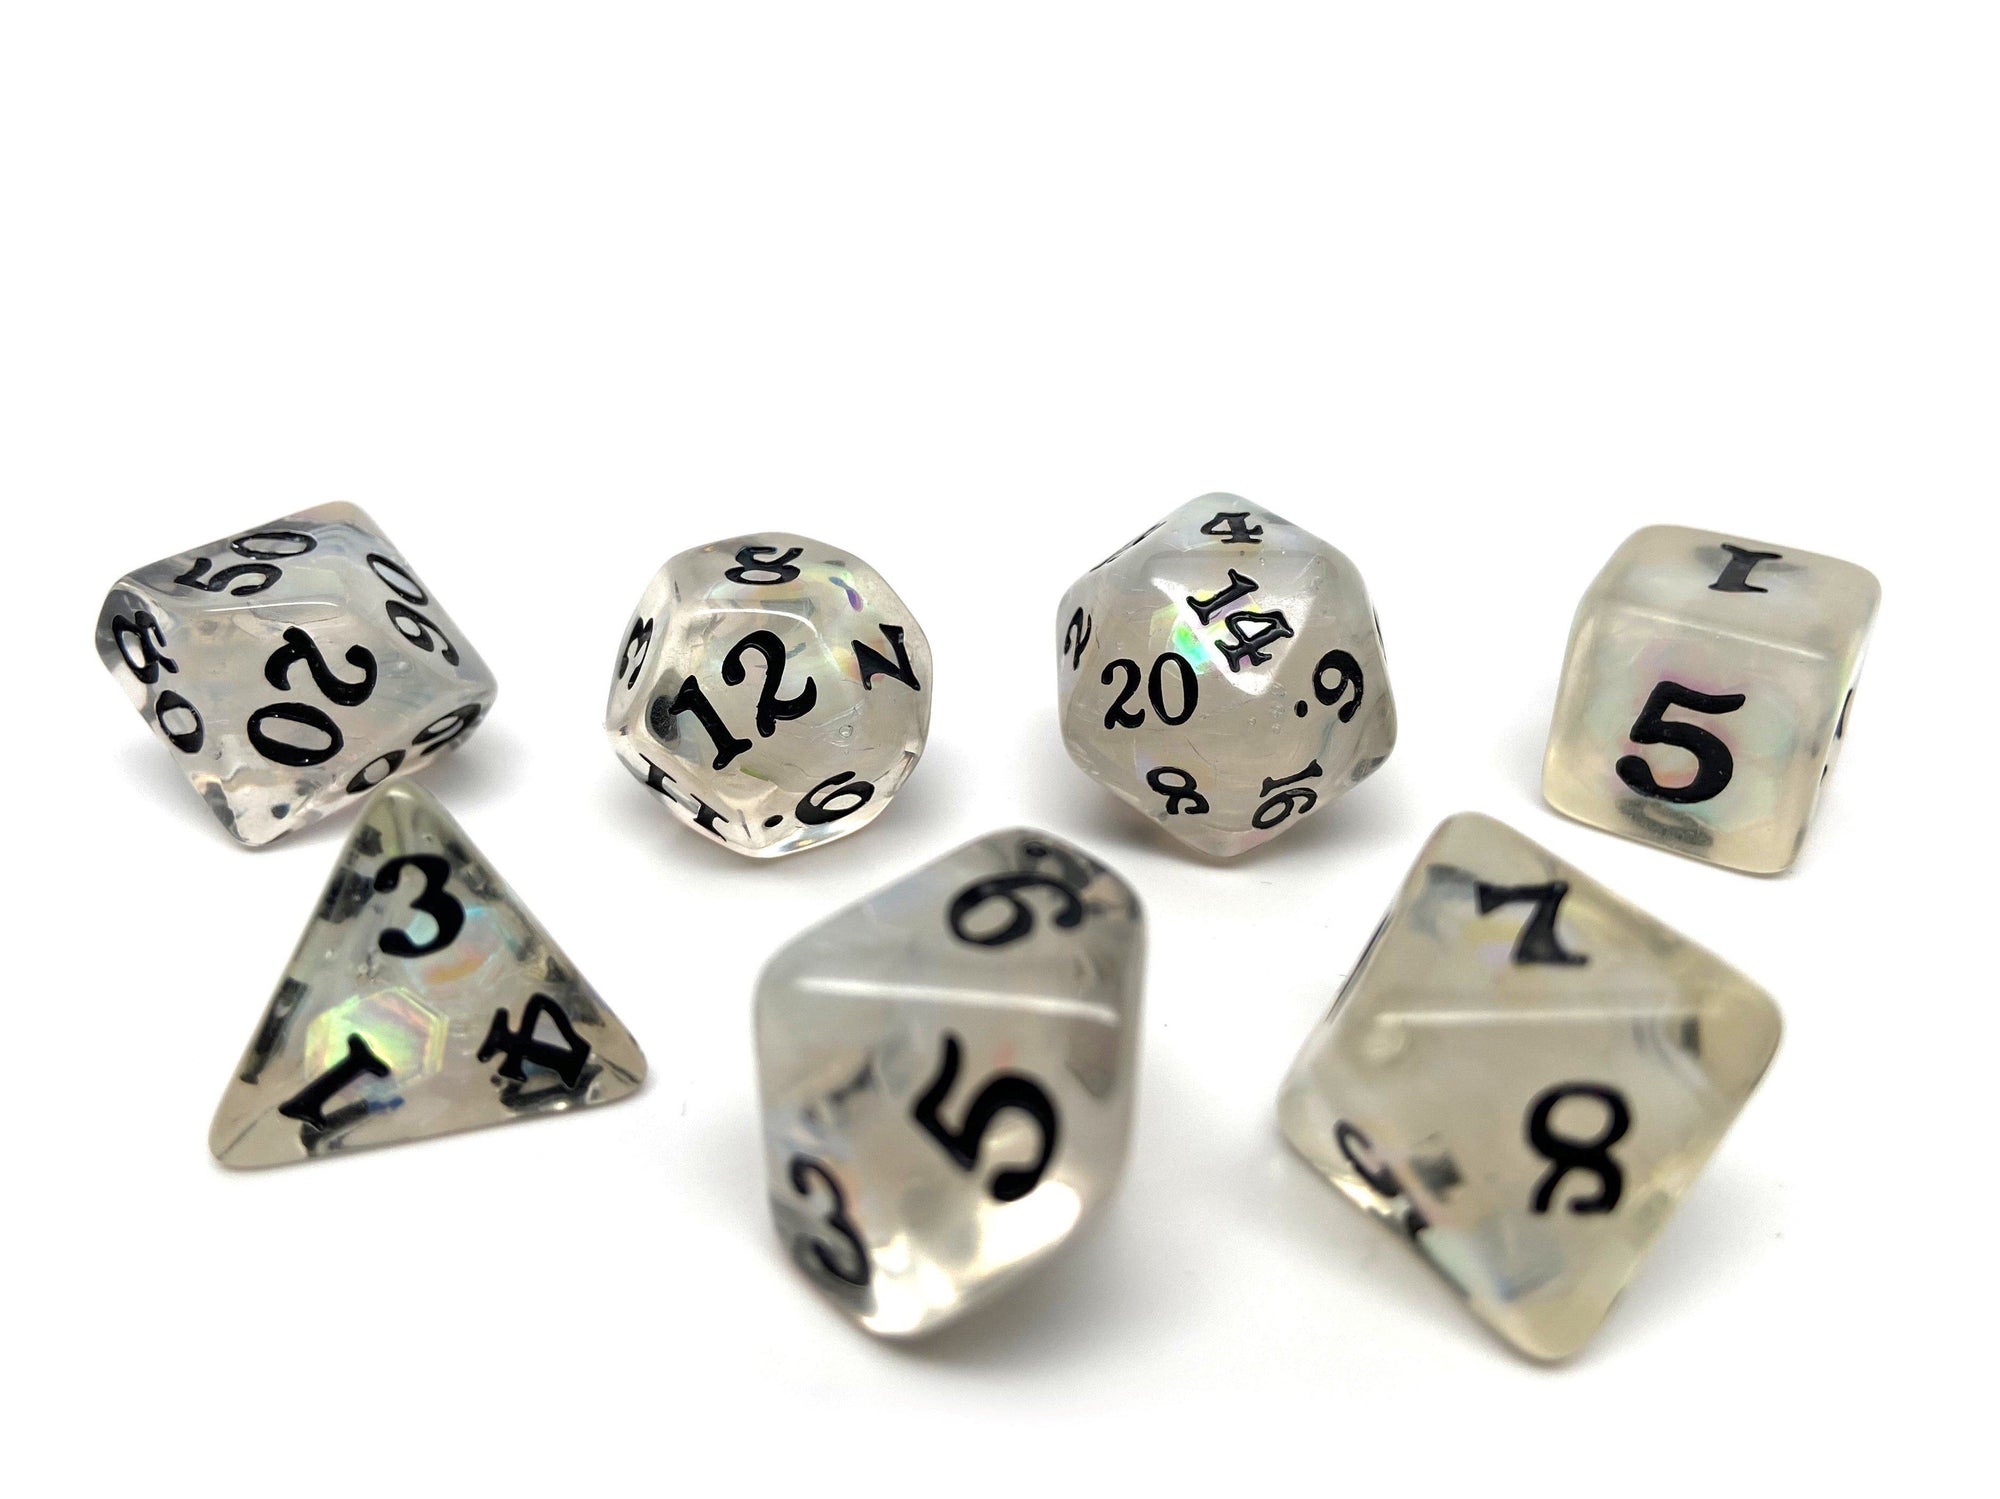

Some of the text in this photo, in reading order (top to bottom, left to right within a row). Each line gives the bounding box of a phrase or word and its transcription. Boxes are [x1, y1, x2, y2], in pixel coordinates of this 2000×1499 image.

[174, 531, 317, 596] 50
[725, 546, 804, 586] 8
[1200, 512, 1263, 544] 4
[1708, 543, 1783, 593] 1
[619, 617, 653, 690] 3
[852, 623, 920, 691] 7
[1064, 606, 1092, 671] 2
[1186, 568, 1294, 672] 14
[112, 610, 205, 753] 80
[248, 625, 378, 767] 20
[669, 630, 817, 770] 12
[1101, 651, 1199, 730] 20
[1616, 681, 1746, 804] 5
[1146, 766, 1210, 815] 8
[1252, 759, 1323, 829] 16
[373, 854, 465, 958] 3
[1474, 880, 1592, 967] 7
[278, 1032, 390, 1132] 1
[477, 993, 592, 1089] 4
[909, 1030, 1058, 1204] 5
[1523, 1079, 1633, 1215] 8
[789, 1152, 870, 1288] 3
